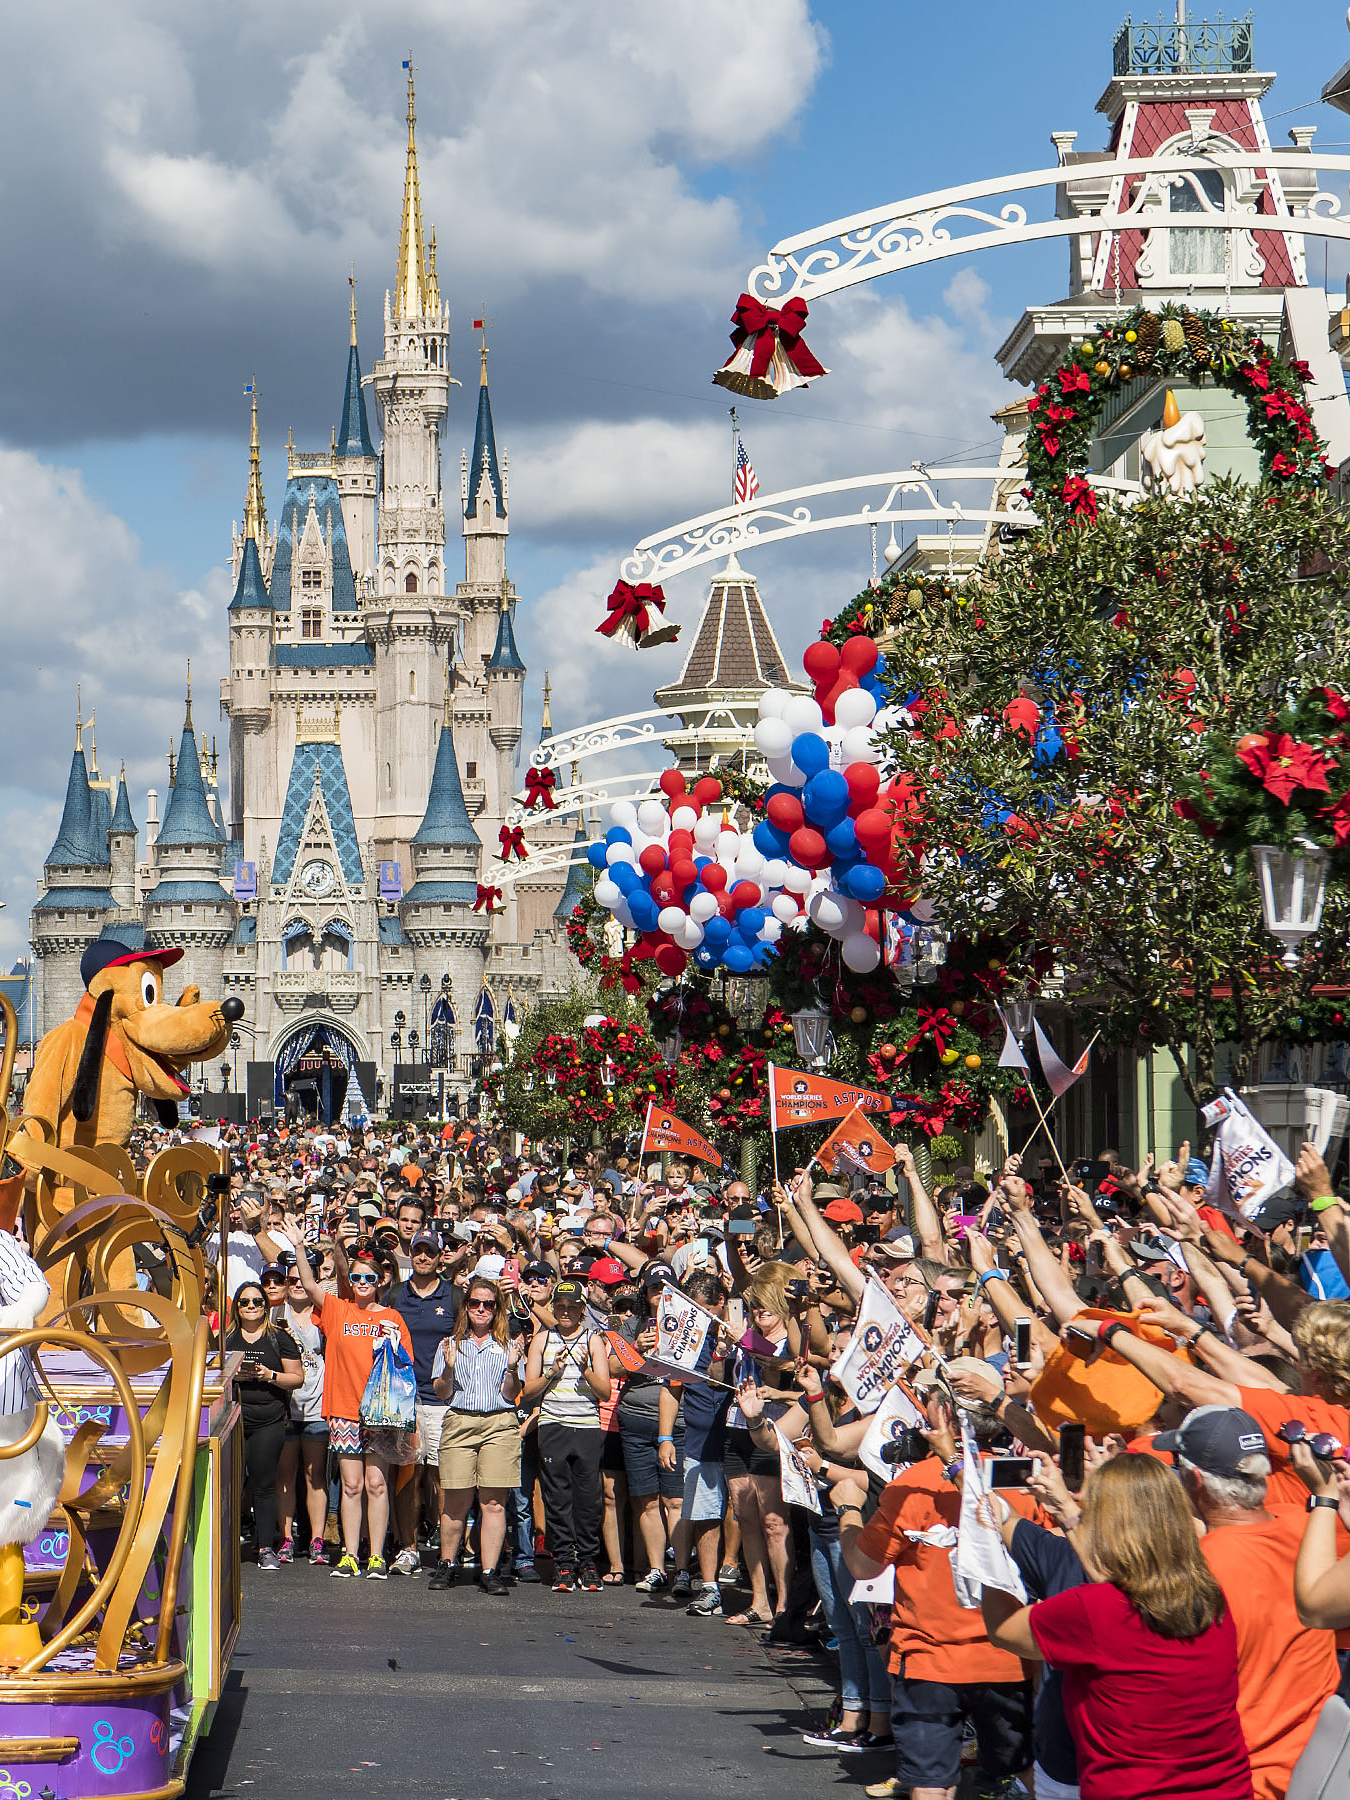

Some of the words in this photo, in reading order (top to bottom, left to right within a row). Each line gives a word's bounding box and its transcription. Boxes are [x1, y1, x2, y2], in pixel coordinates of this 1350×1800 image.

[775, 1100, 828, 1109] CHAMPIONS
[833, 1091, 881, 1111] ASTROS
[686, 1138, 717, 1161] ASTROS
[1095, 1198, 1111, 1207] KC
[669, 1328, 683, 1350] WORLD
[673, 1307, 698, 1360] CHAMPIONS
[856, 1320, 911, 1401] CHAMPIONS
[856, 1349, 883, 1381] WORLD
